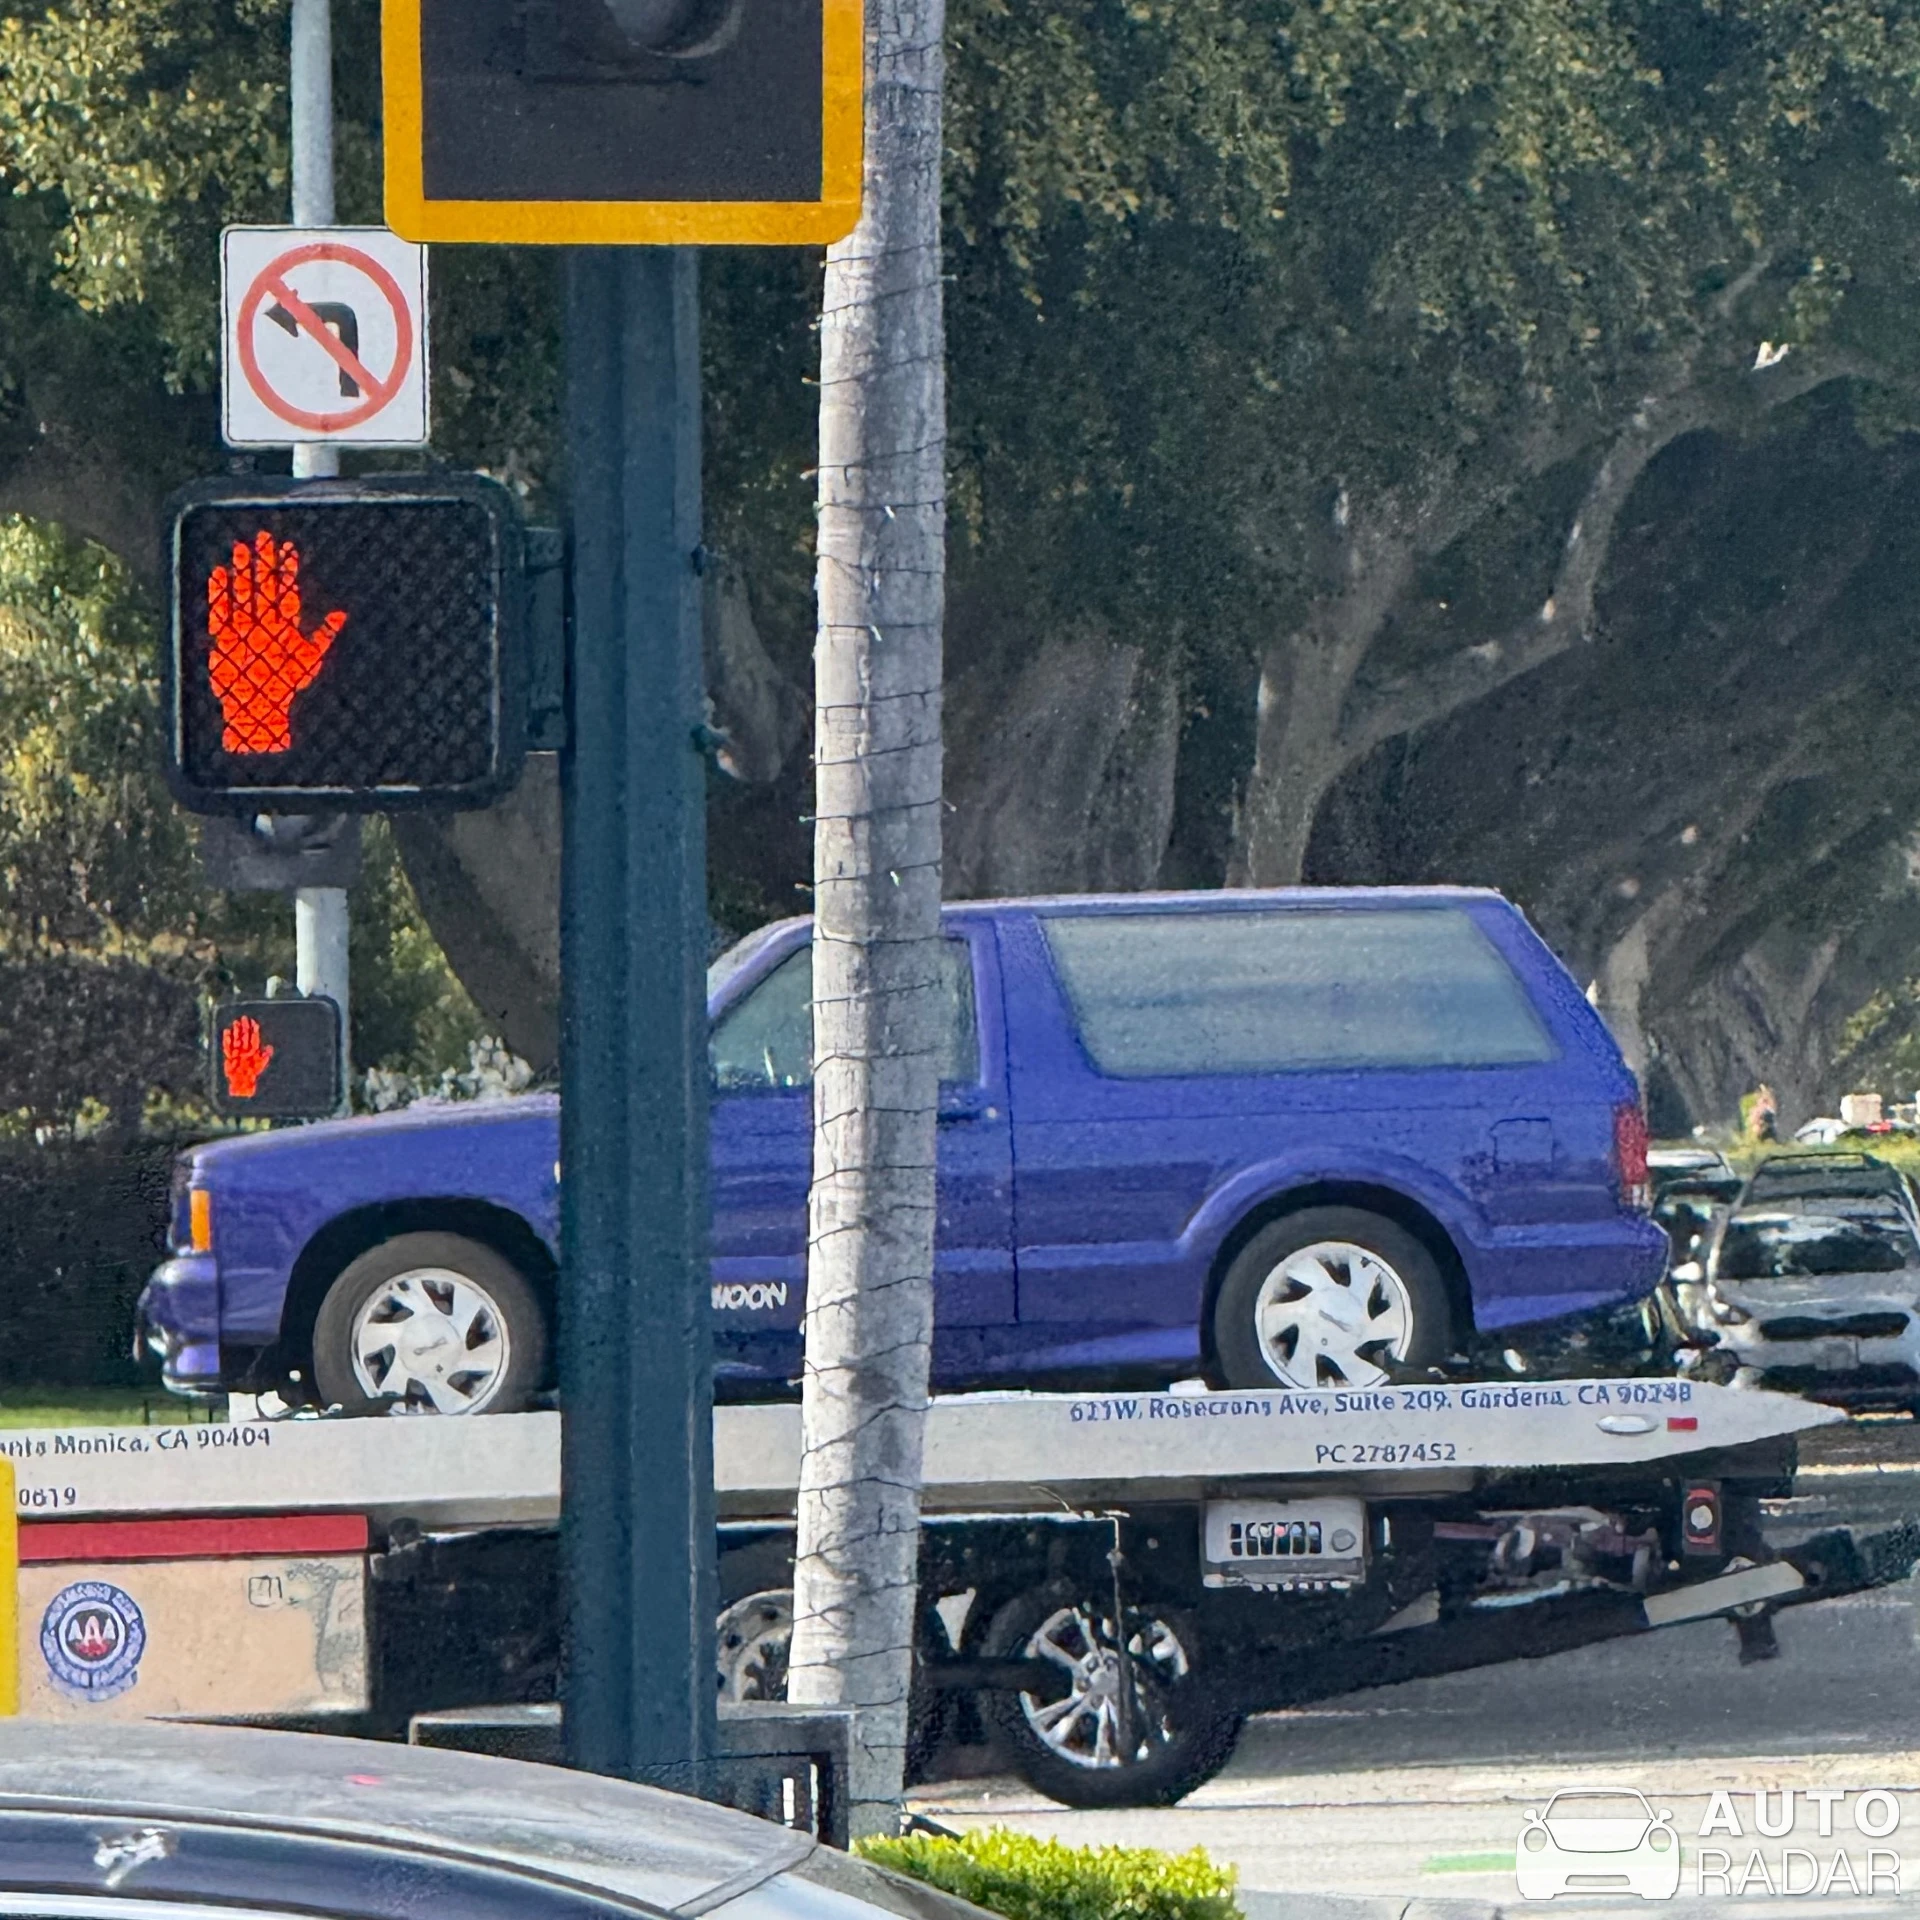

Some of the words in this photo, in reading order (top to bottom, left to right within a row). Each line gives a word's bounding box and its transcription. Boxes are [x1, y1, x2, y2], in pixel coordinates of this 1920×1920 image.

[1280, 1394, 1328, 1416] Ave,
[1335, 1393, 1394, 1412] Suite
[1578, 1385, 1610, 1404] CA
[157, 1429, 188, 1450] CA
